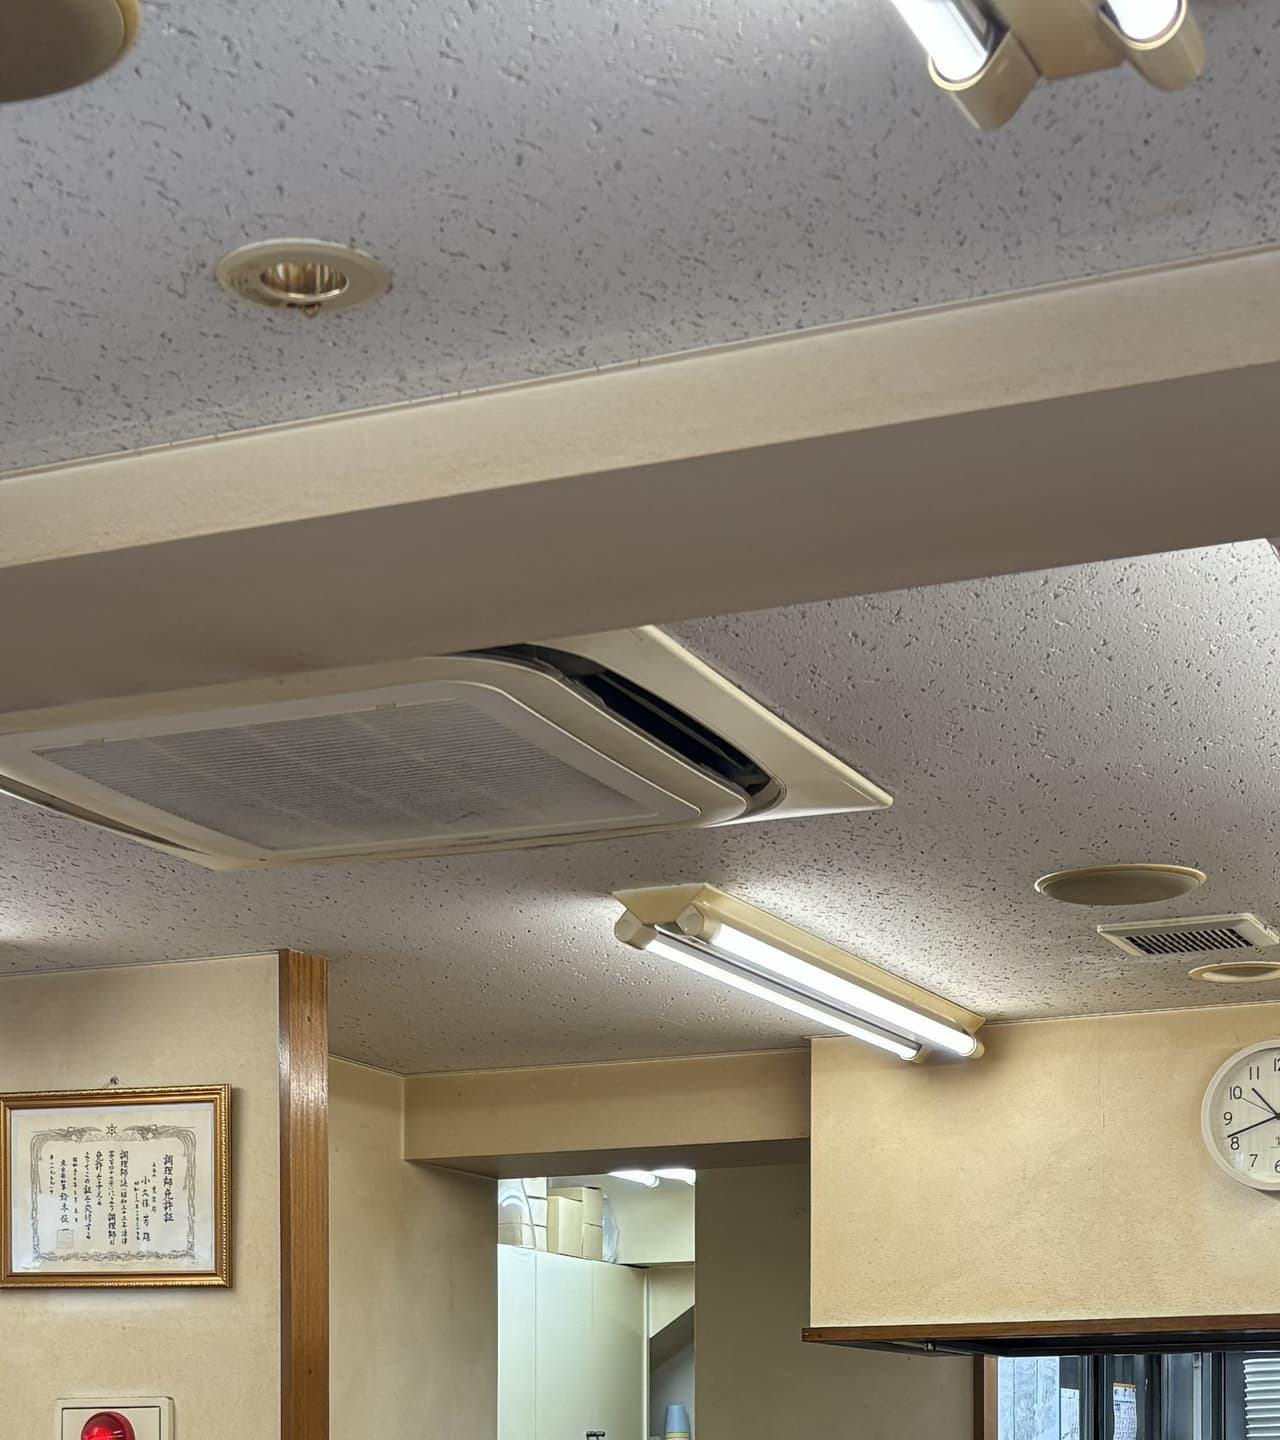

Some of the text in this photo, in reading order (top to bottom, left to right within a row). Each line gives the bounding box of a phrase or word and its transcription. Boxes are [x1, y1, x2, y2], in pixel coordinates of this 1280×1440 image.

[1249, 1066, 1260, 1080] 11
[1229, 1086, 1243, 1100] 10
[1223, 1112, 1233, 1126] 9
[1230, 1136, 1240, 1150] 8
[1249, 1154, 1258, 1167] 7
